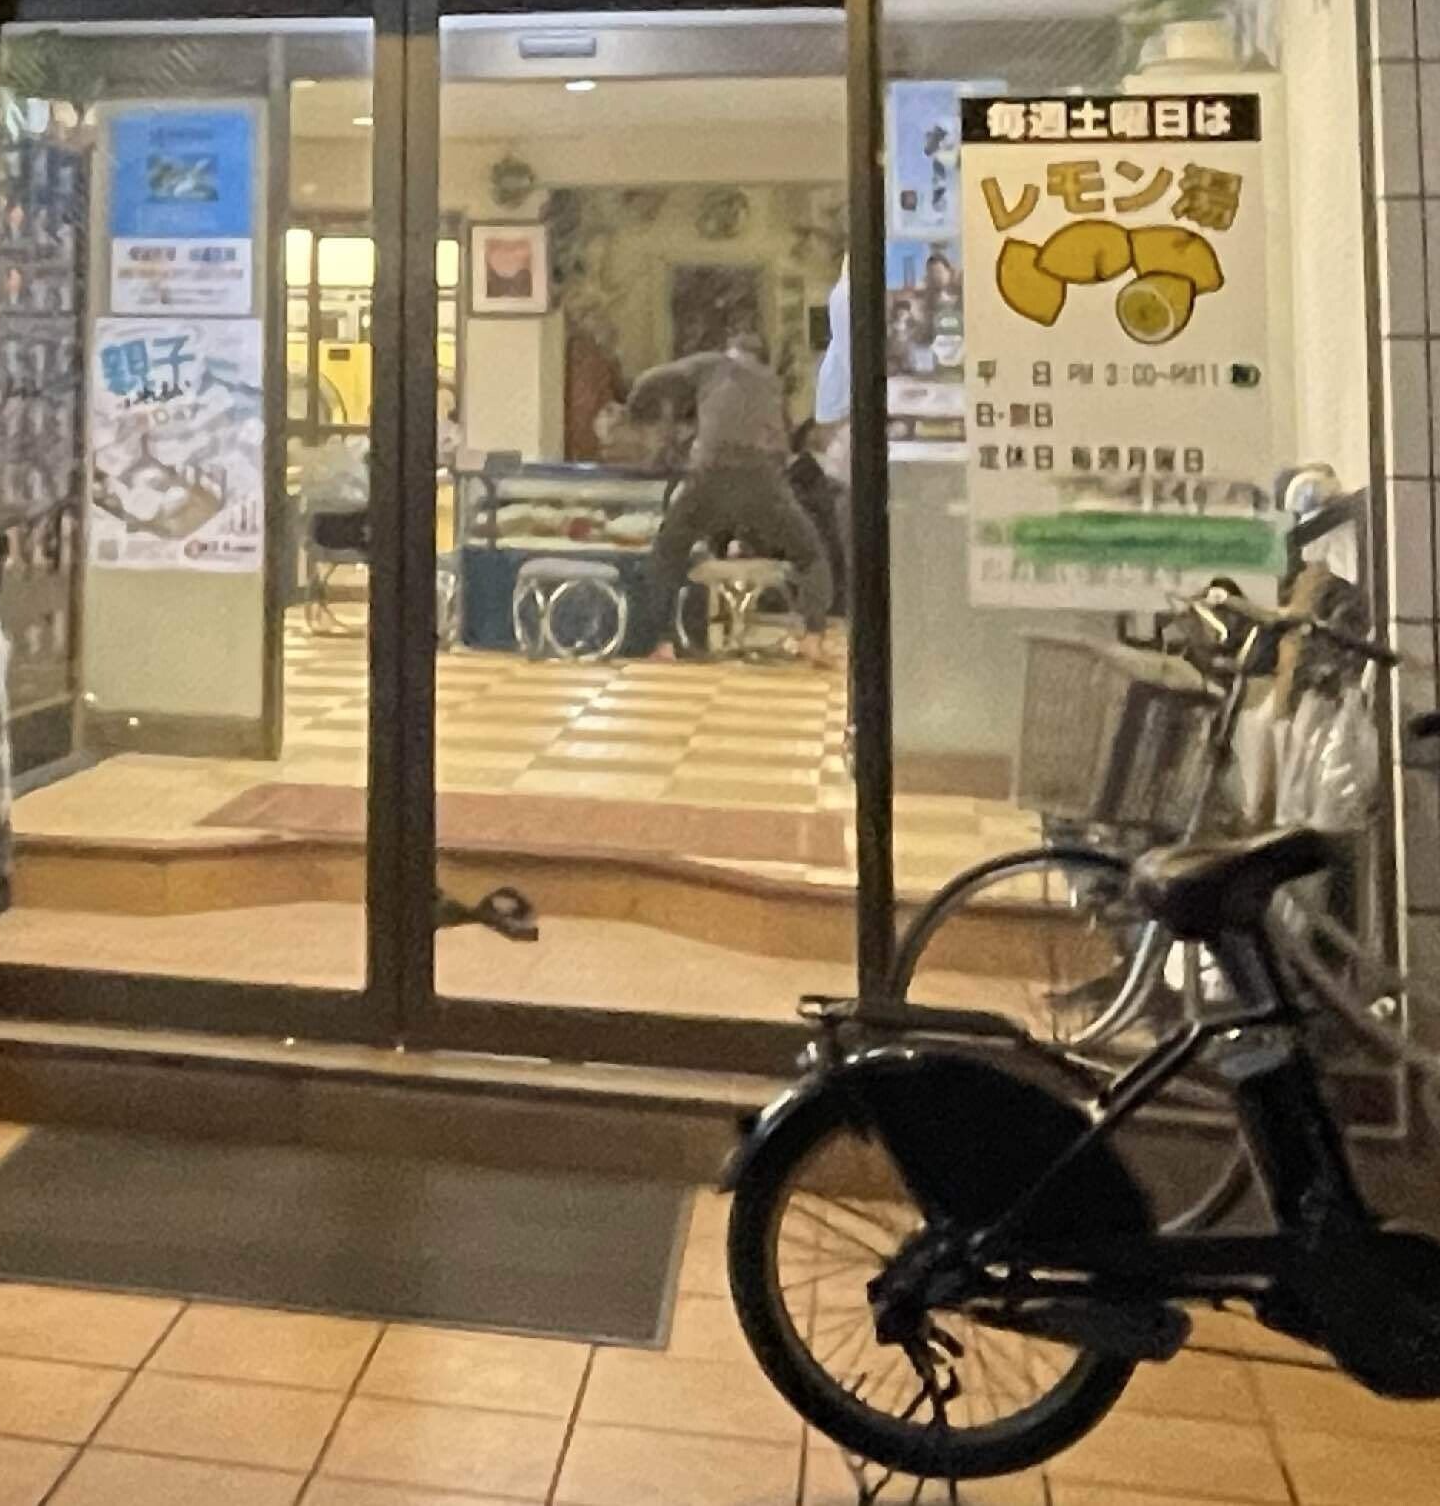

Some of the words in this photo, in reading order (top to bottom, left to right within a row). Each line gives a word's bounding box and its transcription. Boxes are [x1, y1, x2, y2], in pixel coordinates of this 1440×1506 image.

[986, 100, 1232, 139] 毎週土曜日は
[980, 160, 1243, 232] レモン湯
